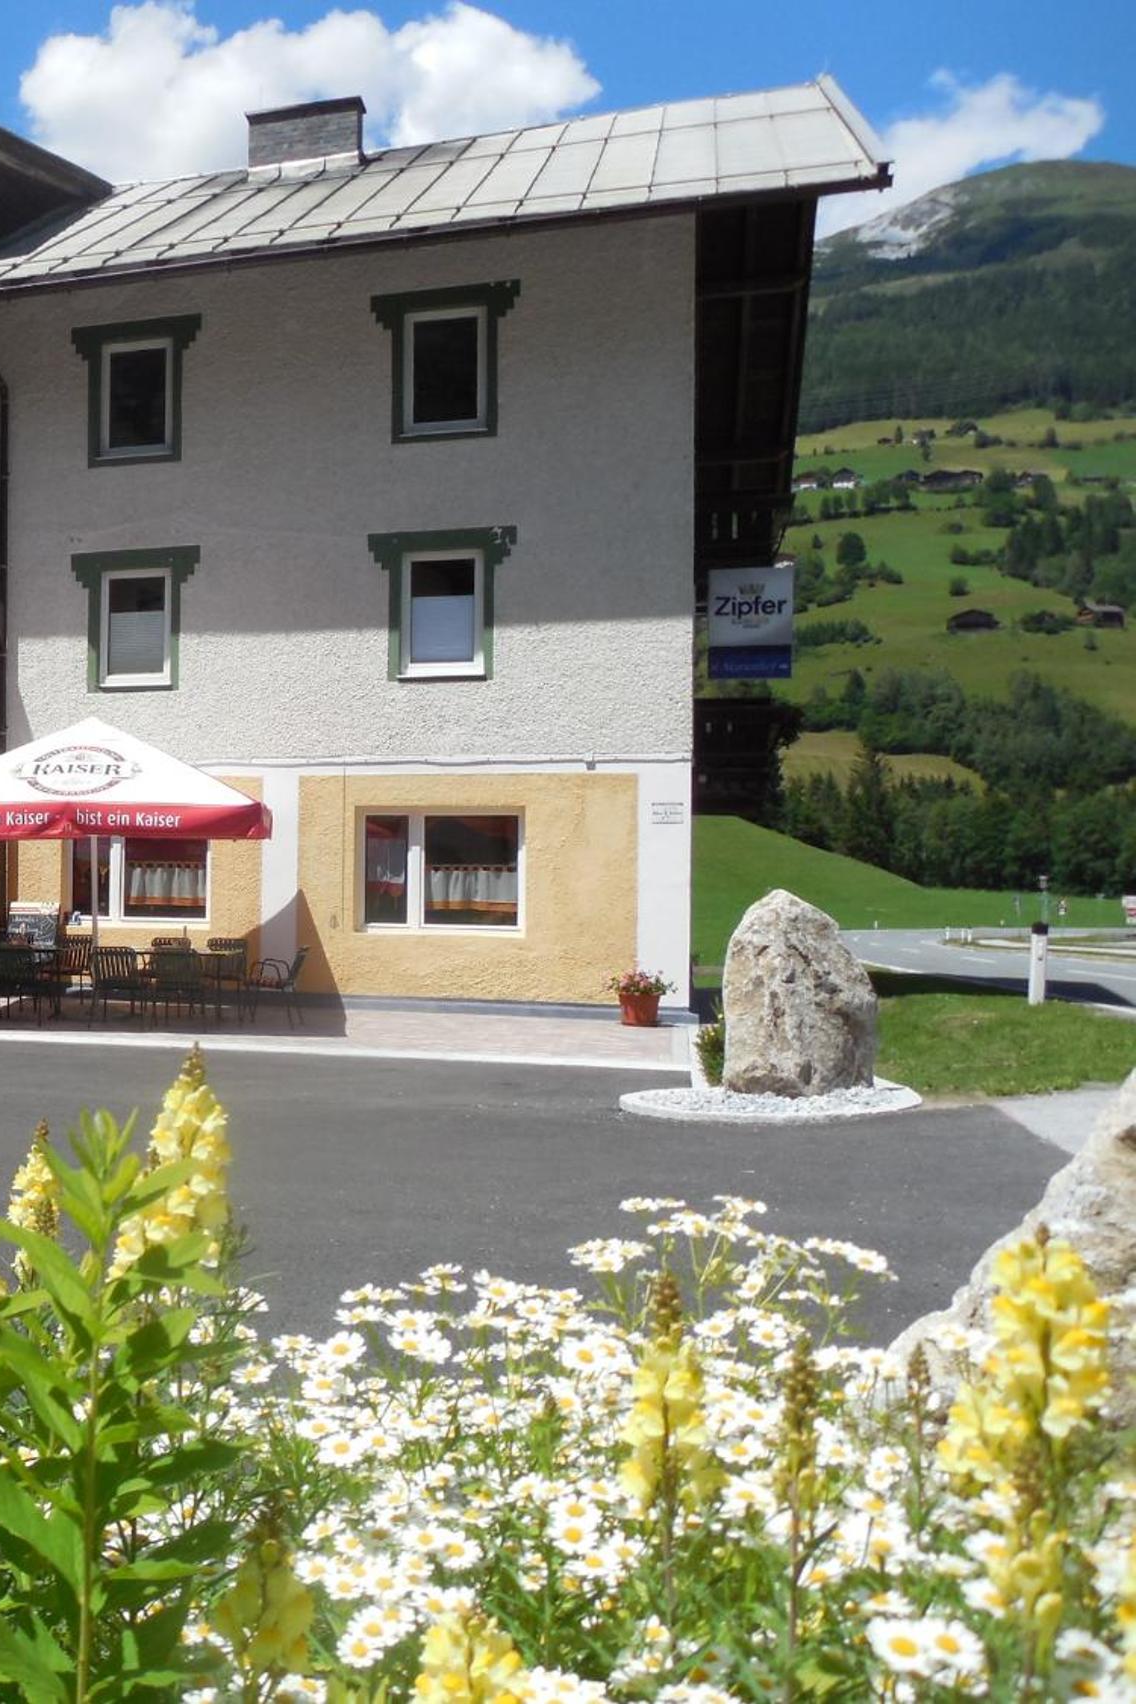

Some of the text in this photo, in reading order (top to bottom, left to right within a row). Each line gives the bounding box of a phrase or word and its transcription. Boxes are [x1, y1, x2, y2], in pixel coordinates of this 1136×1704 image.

[714, 595, 787, 619] Zipfer
[32, 763, 122, 775] KAISER
[6, 810, 51, 825] Kaiser
[76, 809, 102, 825] bist
[107, 810, 130, 826] ein
[135, 812, 181, 828] Kaiser
